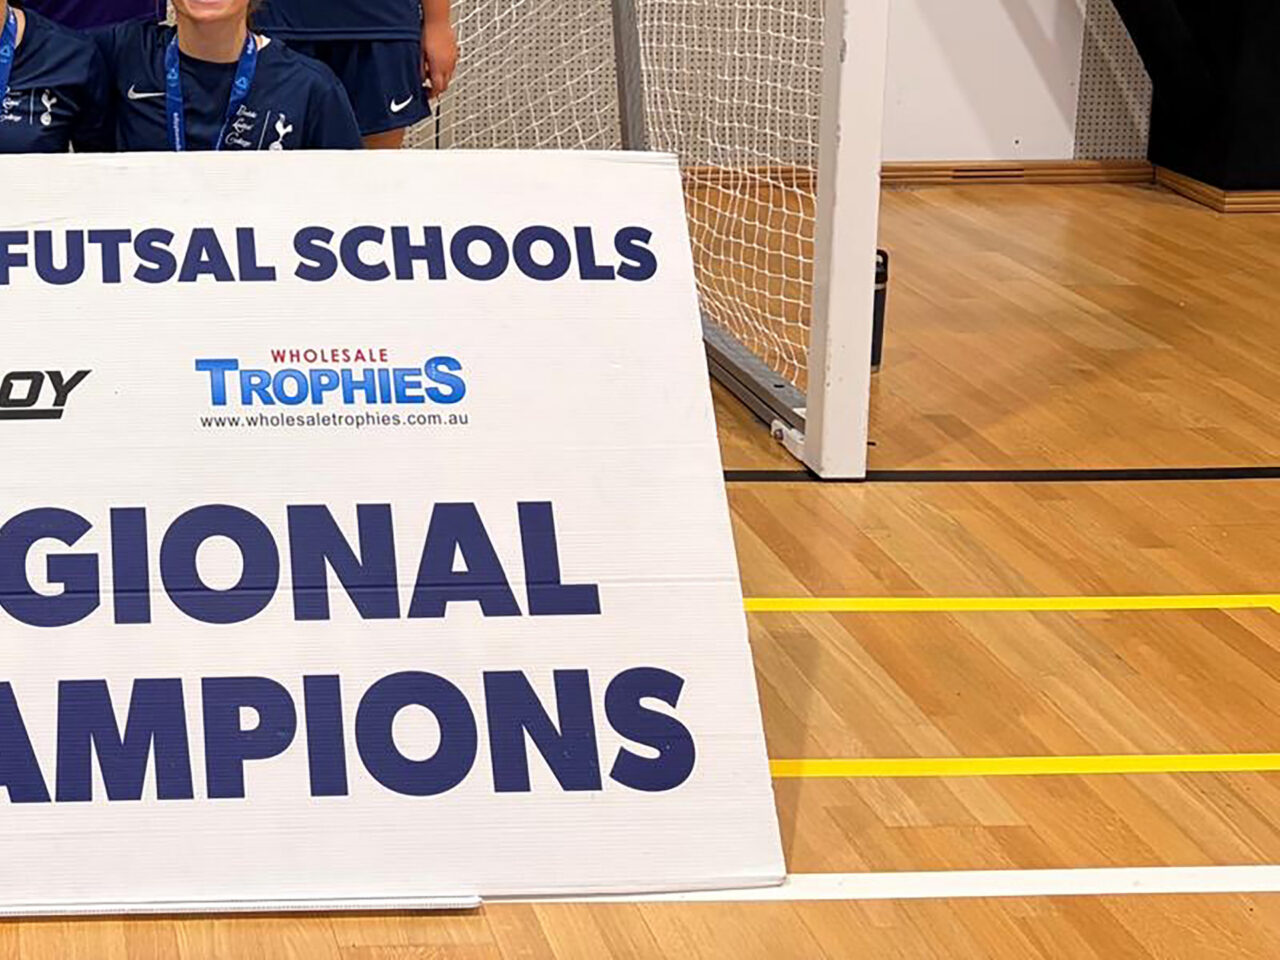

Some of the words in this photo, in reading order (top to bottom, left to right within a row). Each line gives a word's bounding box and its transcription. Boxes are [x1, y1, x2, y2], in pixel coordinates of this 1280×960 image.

[293, 225, 657, 282] SCHOOLS
[271, 348, 389, 363] WHOLESALE
[200, 412, 468, 428] www.wholesaletrophies.com.au
